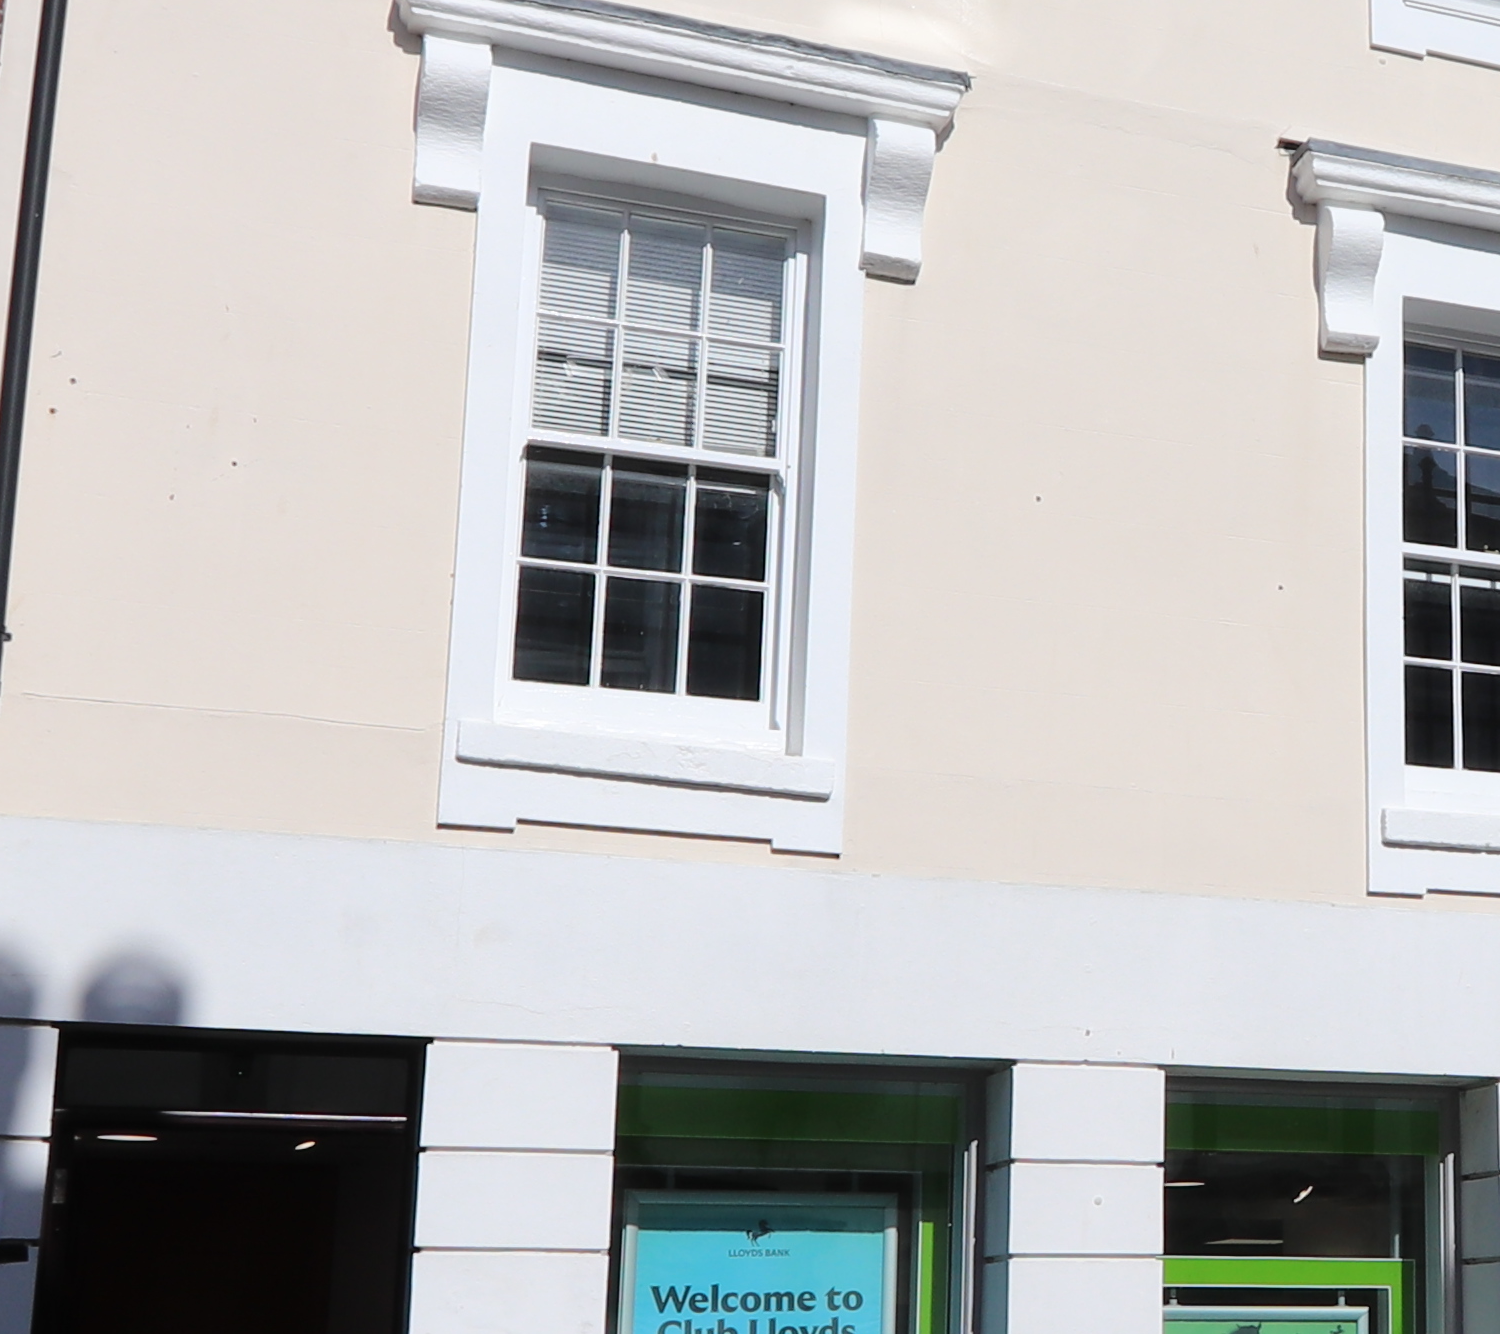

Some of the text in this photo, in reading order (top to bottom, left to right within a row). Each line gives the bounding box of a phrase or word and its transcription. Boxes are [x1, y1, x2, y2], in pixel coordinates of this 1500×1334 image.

[728, 1248, 790, 1257] LLOYDS BANK
[650, 1283, 863, 1314] Welcome to
